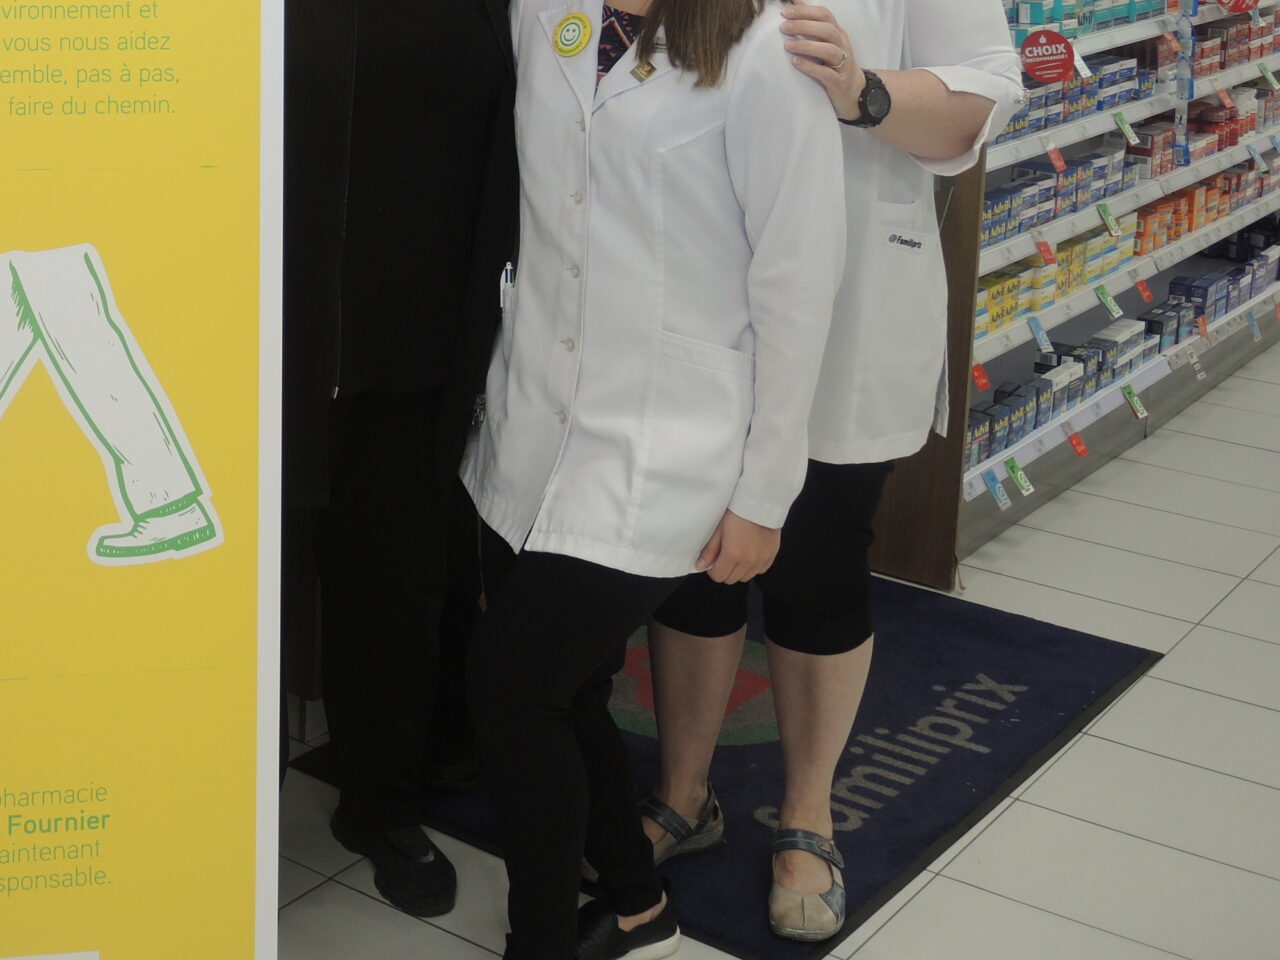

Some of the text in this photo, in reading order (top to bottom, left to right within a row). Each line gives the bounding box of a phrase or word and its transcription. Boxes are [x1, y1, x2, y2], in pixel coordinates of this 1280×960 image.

[139, 1, 158, 18] et
[3, 37, 51, 51] vous
[60, 37, 109, 51] nous
[117, 32, 170, 50] aidez
[1025, 43, 1066, 57] CHOIX
[77, 69, 112, 88] pas
[120, 64, 131, 82] à
[140, 68, 179, 87] pas,
[9, 96, 53, 115] faire
[62, 96, 86, 115] du
[95, 95, 175, 114] chemin.
[974, 421, 991, 438] Advil
[7, 810, 112, 836] Fournier
